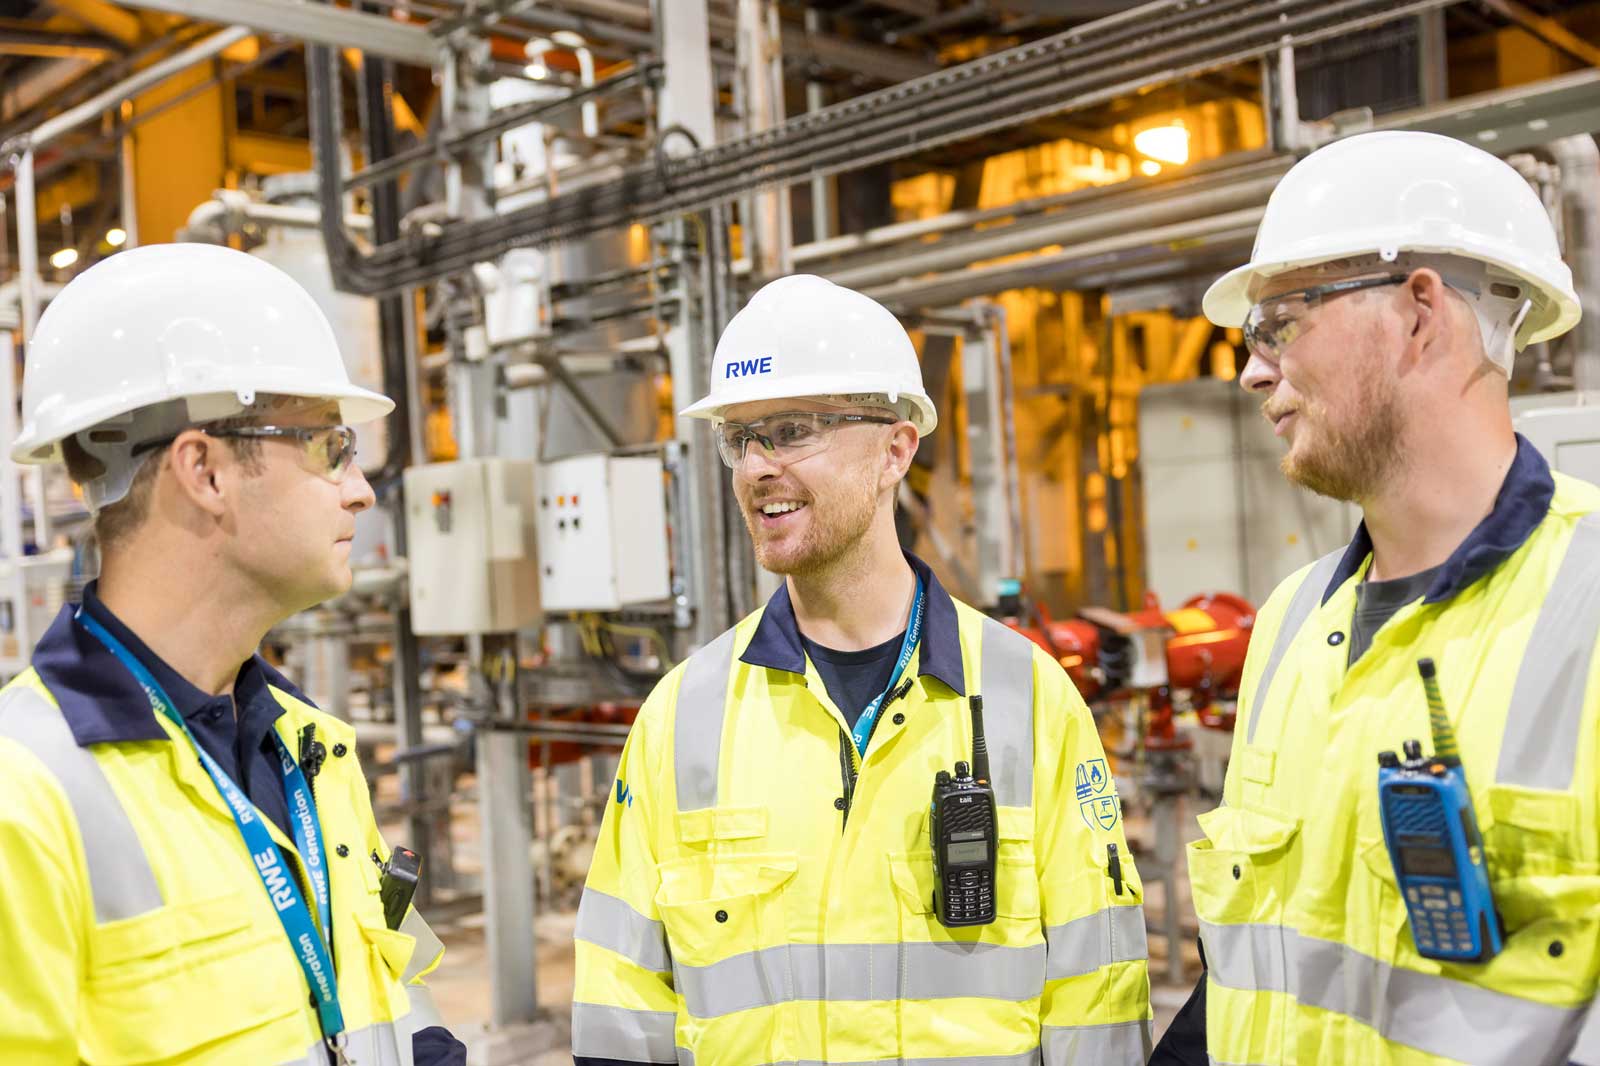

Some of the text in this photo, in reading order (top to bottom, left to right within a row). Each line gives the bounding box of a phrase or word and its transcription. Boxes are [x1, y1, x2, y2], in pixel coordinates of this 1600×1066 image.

[726, 357, 772, 378] RWE
[900, 591, 926, 669] RWE Generation
[226, 791, 254, 825] RWE
[294, 789, 320, 868] Generation
[254, 847, 333, 1002] RWE eneration
